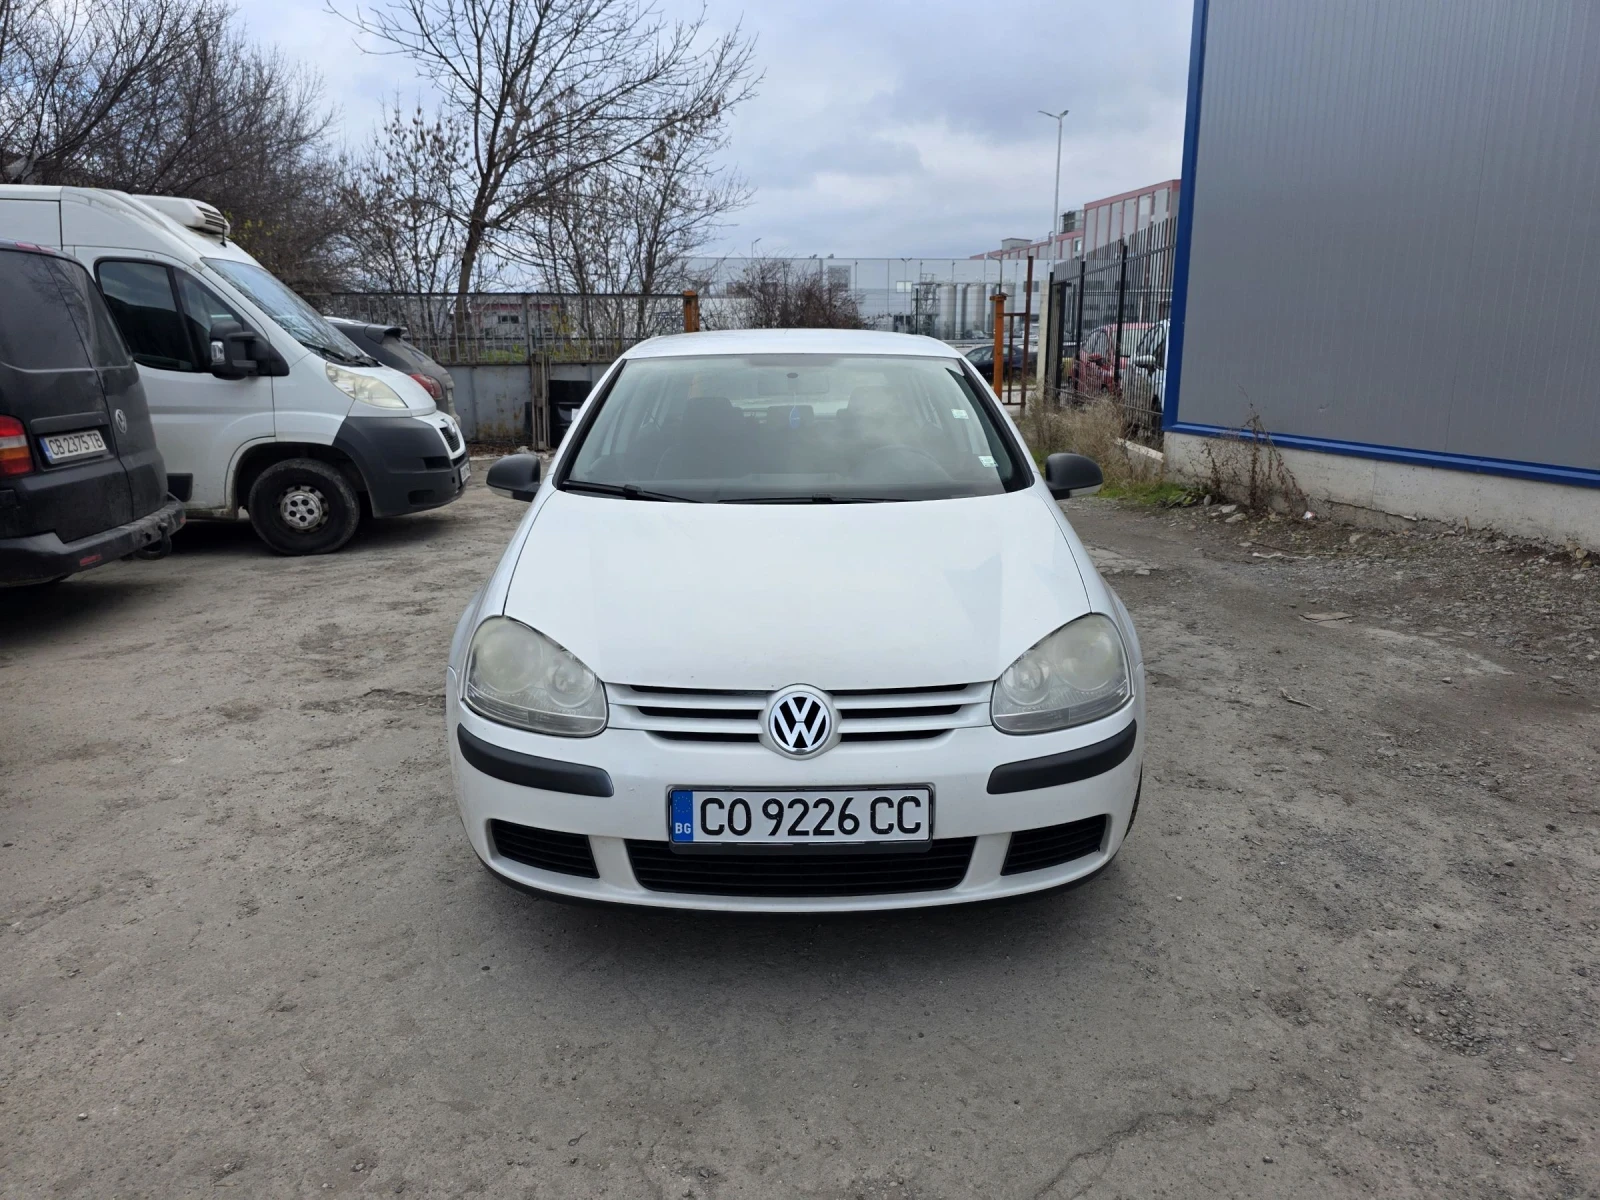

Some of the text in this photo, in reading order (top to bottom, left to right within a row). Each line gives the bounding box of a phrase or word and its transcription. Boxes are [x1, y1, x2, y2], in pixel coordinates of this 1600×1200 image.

[49, 432, 103, 456] CB 2375 TB
[770, 691, 831, 753] VW
[675, 823, 692, 835] BG
[762, 797, 860, 836] 9226
[870, 796, 921, 835] CC
